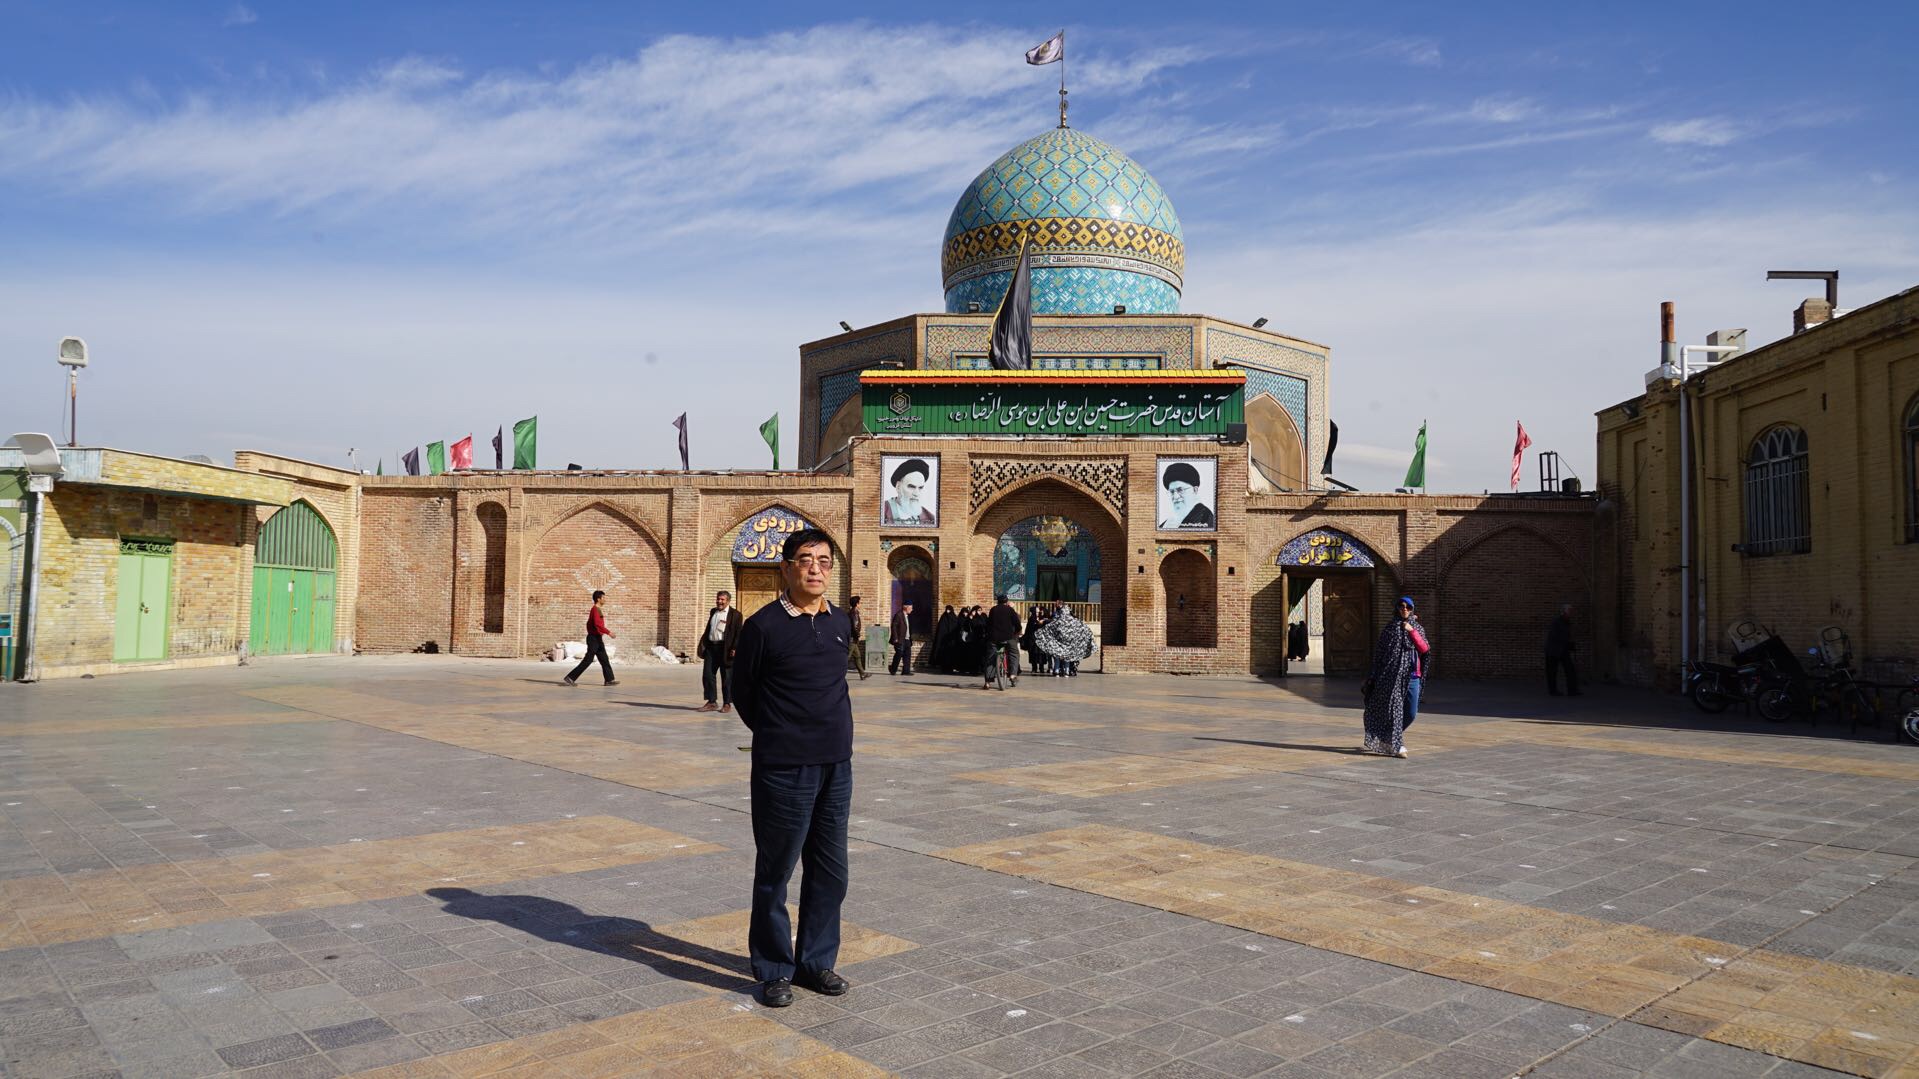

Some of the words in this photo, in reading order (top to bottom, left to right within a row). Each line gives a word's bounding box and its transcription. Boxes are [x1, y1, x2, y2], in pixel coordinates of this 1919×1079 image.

[1000, 403, 1028, 426] موسی
[1026, 397, 1050, 430] ابن
[1047, 399, 1067, 426] علی
[1065, 397, 1088, 430] ابن
[1084, 398, 1118, 430] حسین
[1109, 395, 1158, 428] حضرت
[1152, 394, 1186, 426] قدس
[1181, 394, 1230, 426] آستان
[753, 516, 804, 532] ورودی
[1299, 547, 1354, 565] خواهران
[1310, 535, 1342, 546] ورودی
